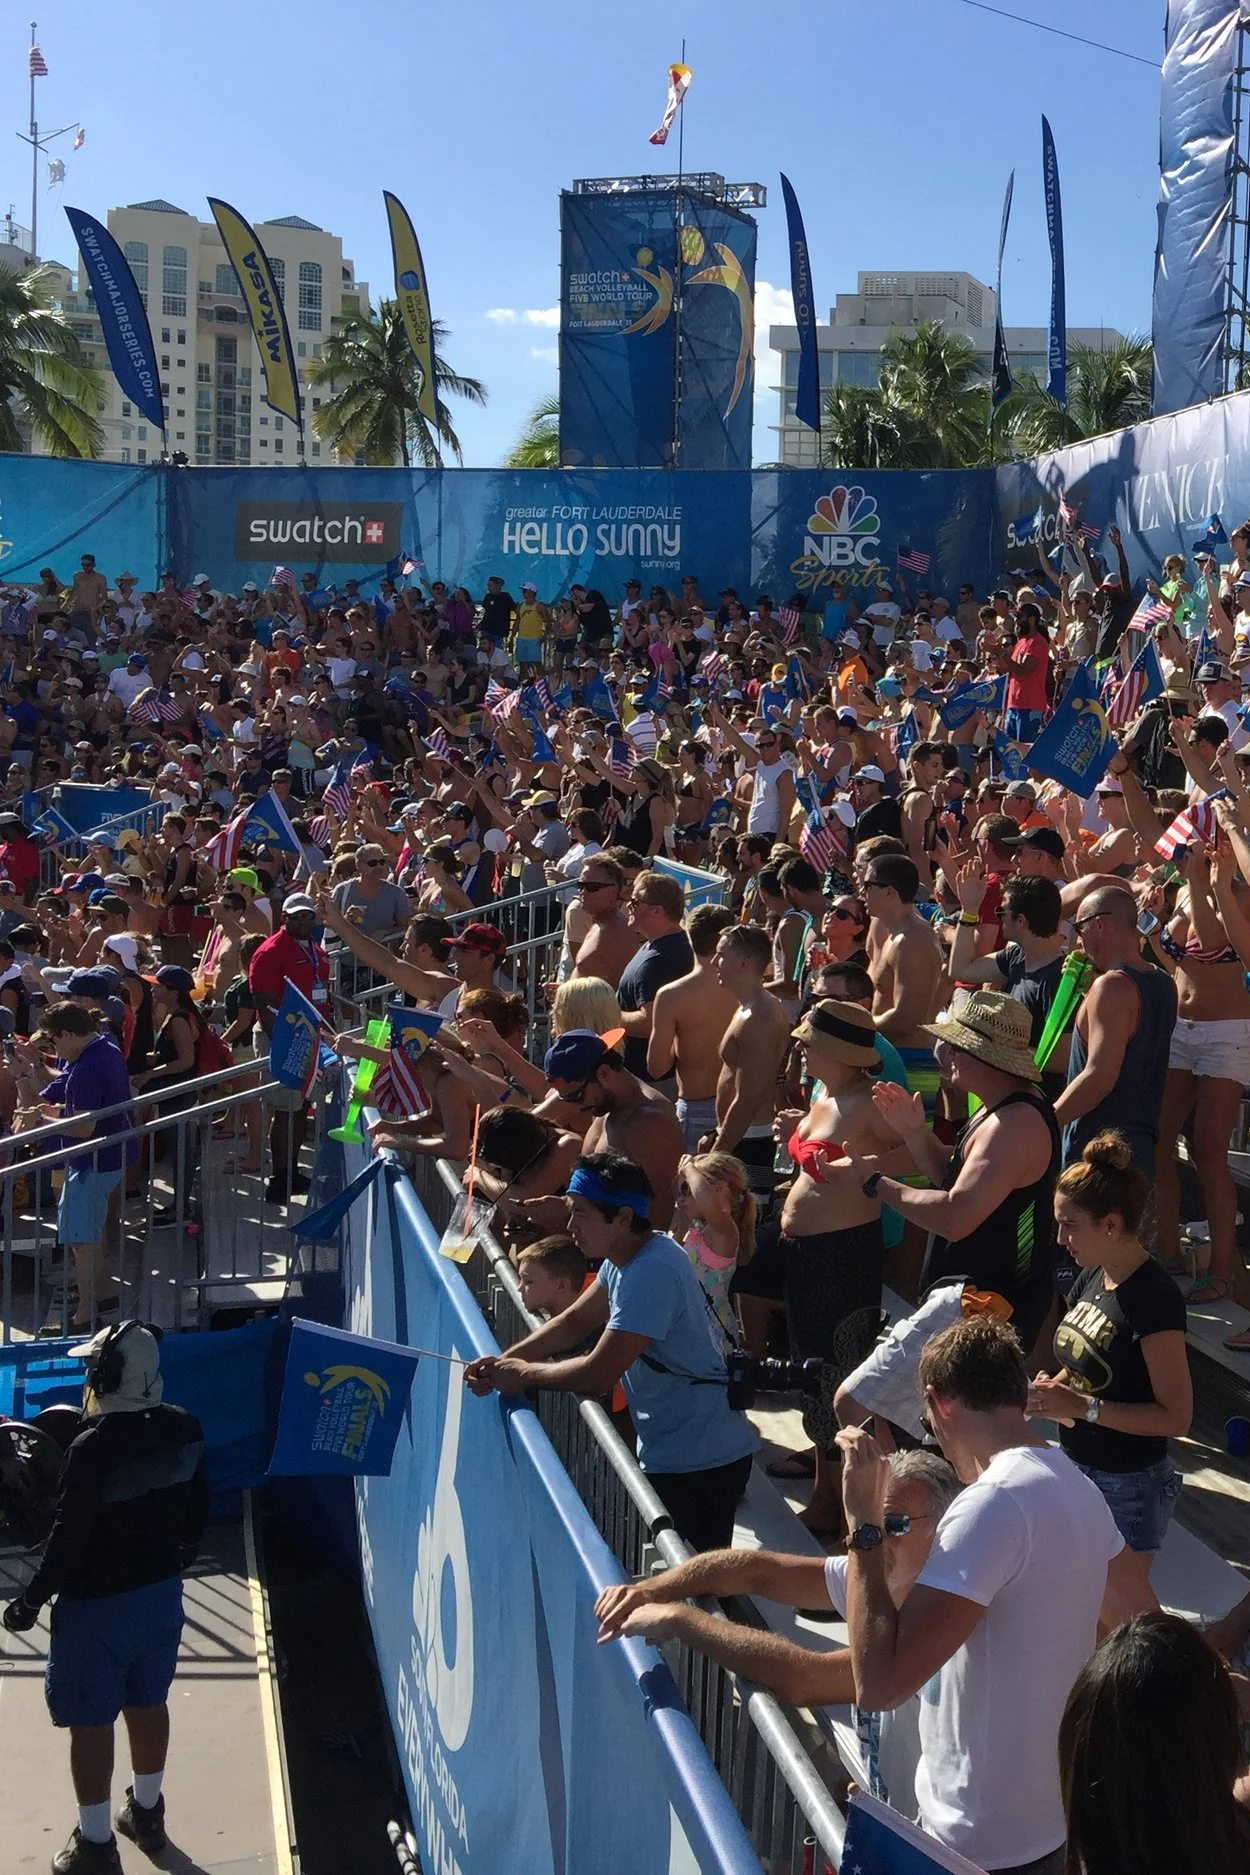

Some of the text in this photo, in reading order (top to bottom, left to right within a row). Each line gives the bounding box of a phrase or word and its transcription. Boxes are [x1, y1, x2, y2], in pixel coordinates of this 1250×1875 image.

[570, 270, 620, 285] swatch
[81, 226, 154, 398] SWATCHMAJORSERIES.COM
[569, 292, 653, 303] FIVB WORLD TOUR
[506, 505, 682, 521] greater FORT LAUDERDALE
[249, 516, 362, 544] swatch
[640, 560, 681, 571] sunny.org
[803, 536, 881, 567] NBC
[789, 555, 890, 595] Sports
[1054, 725, 1081, 762] swatch
[312, 1407, 331, 1451] swatch
[341, 1388, 373, 1461] FINALS
